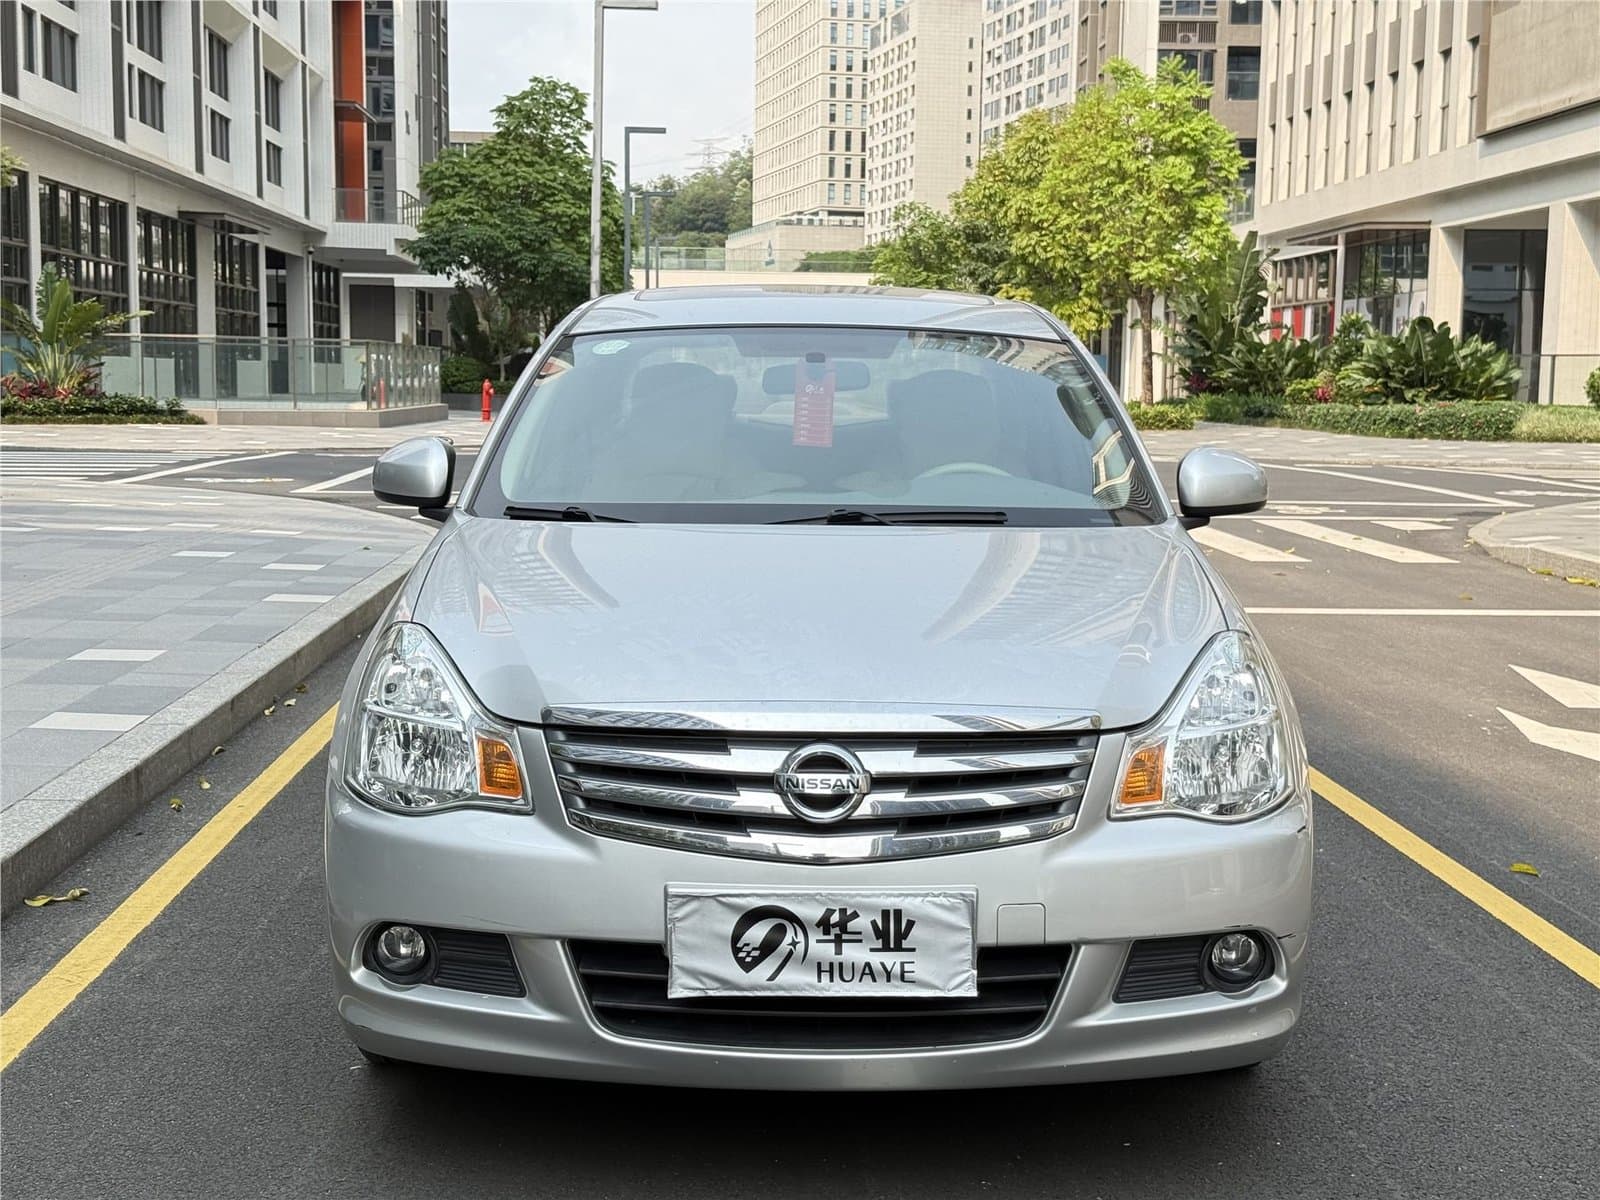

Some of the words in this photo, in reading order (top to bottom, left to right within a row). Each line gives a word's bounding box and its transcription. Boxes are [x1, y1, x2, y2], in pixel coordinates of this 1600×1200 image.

[785, 778, 860, 790] NISSAN
[815, 907, 917, 956] 华业
[816, 961, 916, 984] HUAYE
